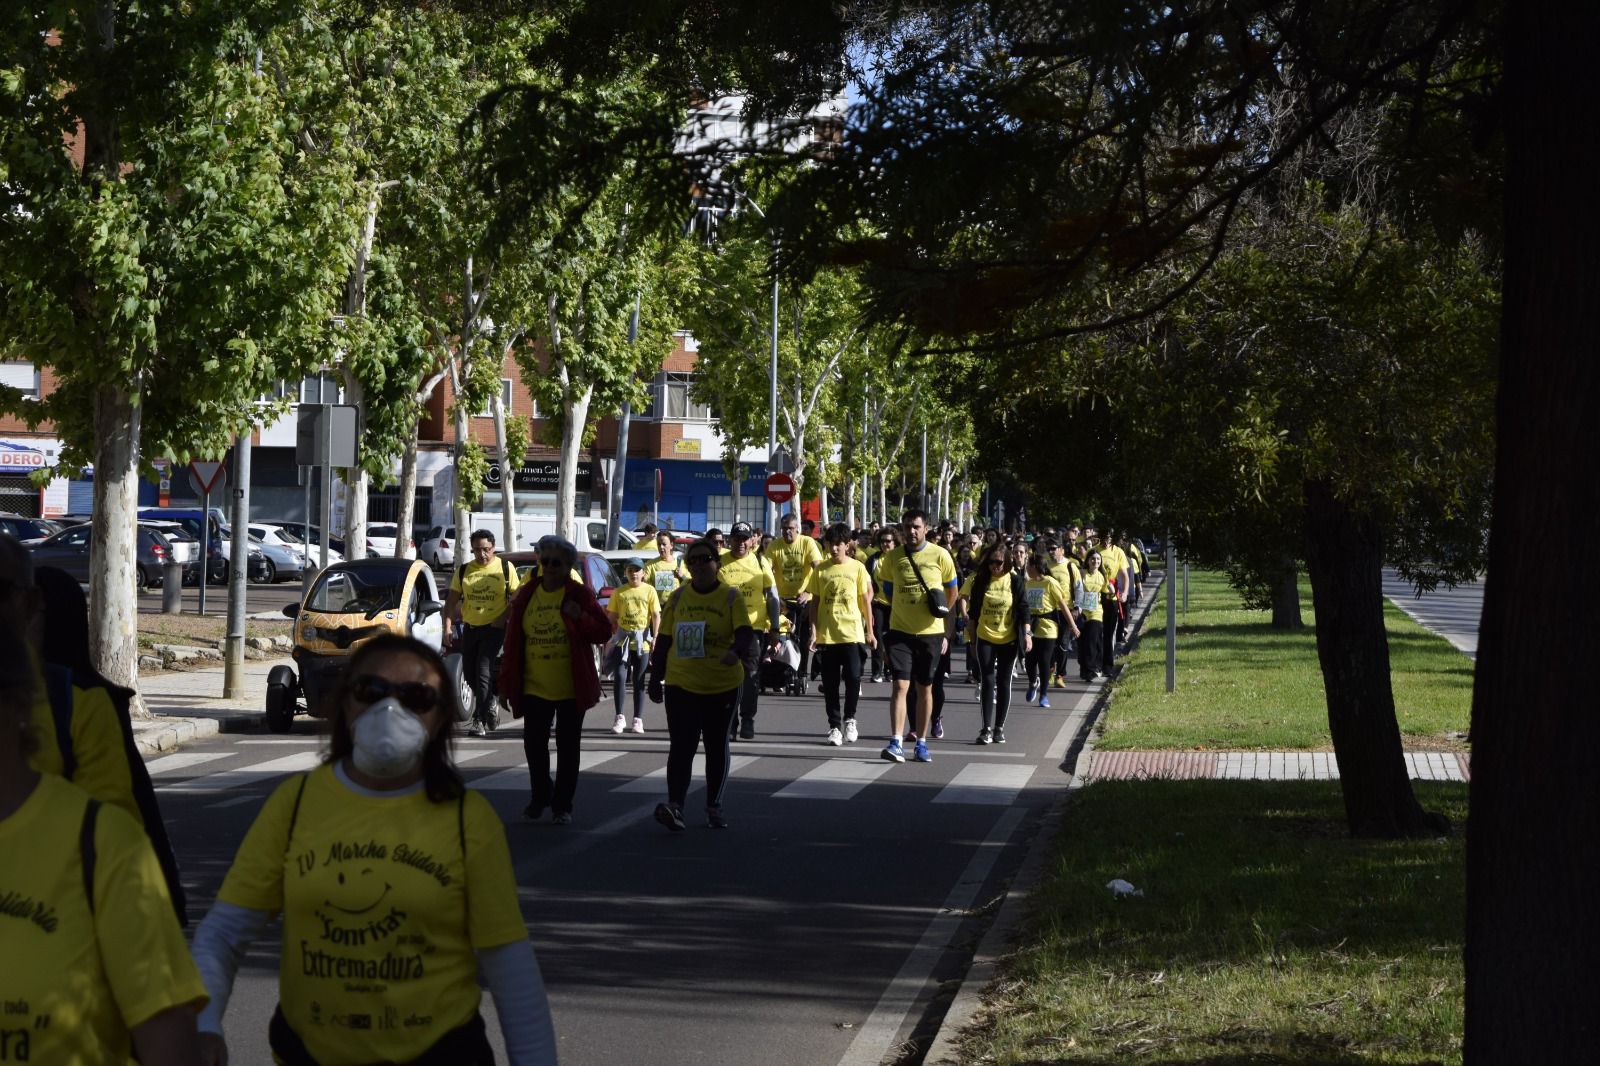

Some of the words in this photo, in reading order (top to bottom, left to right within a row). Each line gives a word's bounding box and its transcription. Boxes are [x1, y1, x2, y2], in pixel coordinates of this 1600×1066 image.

[297, 850, 315, 877] IV
[323, 840, 387, 867] Marcha
[391, 843, 451, 888] Solidaria
